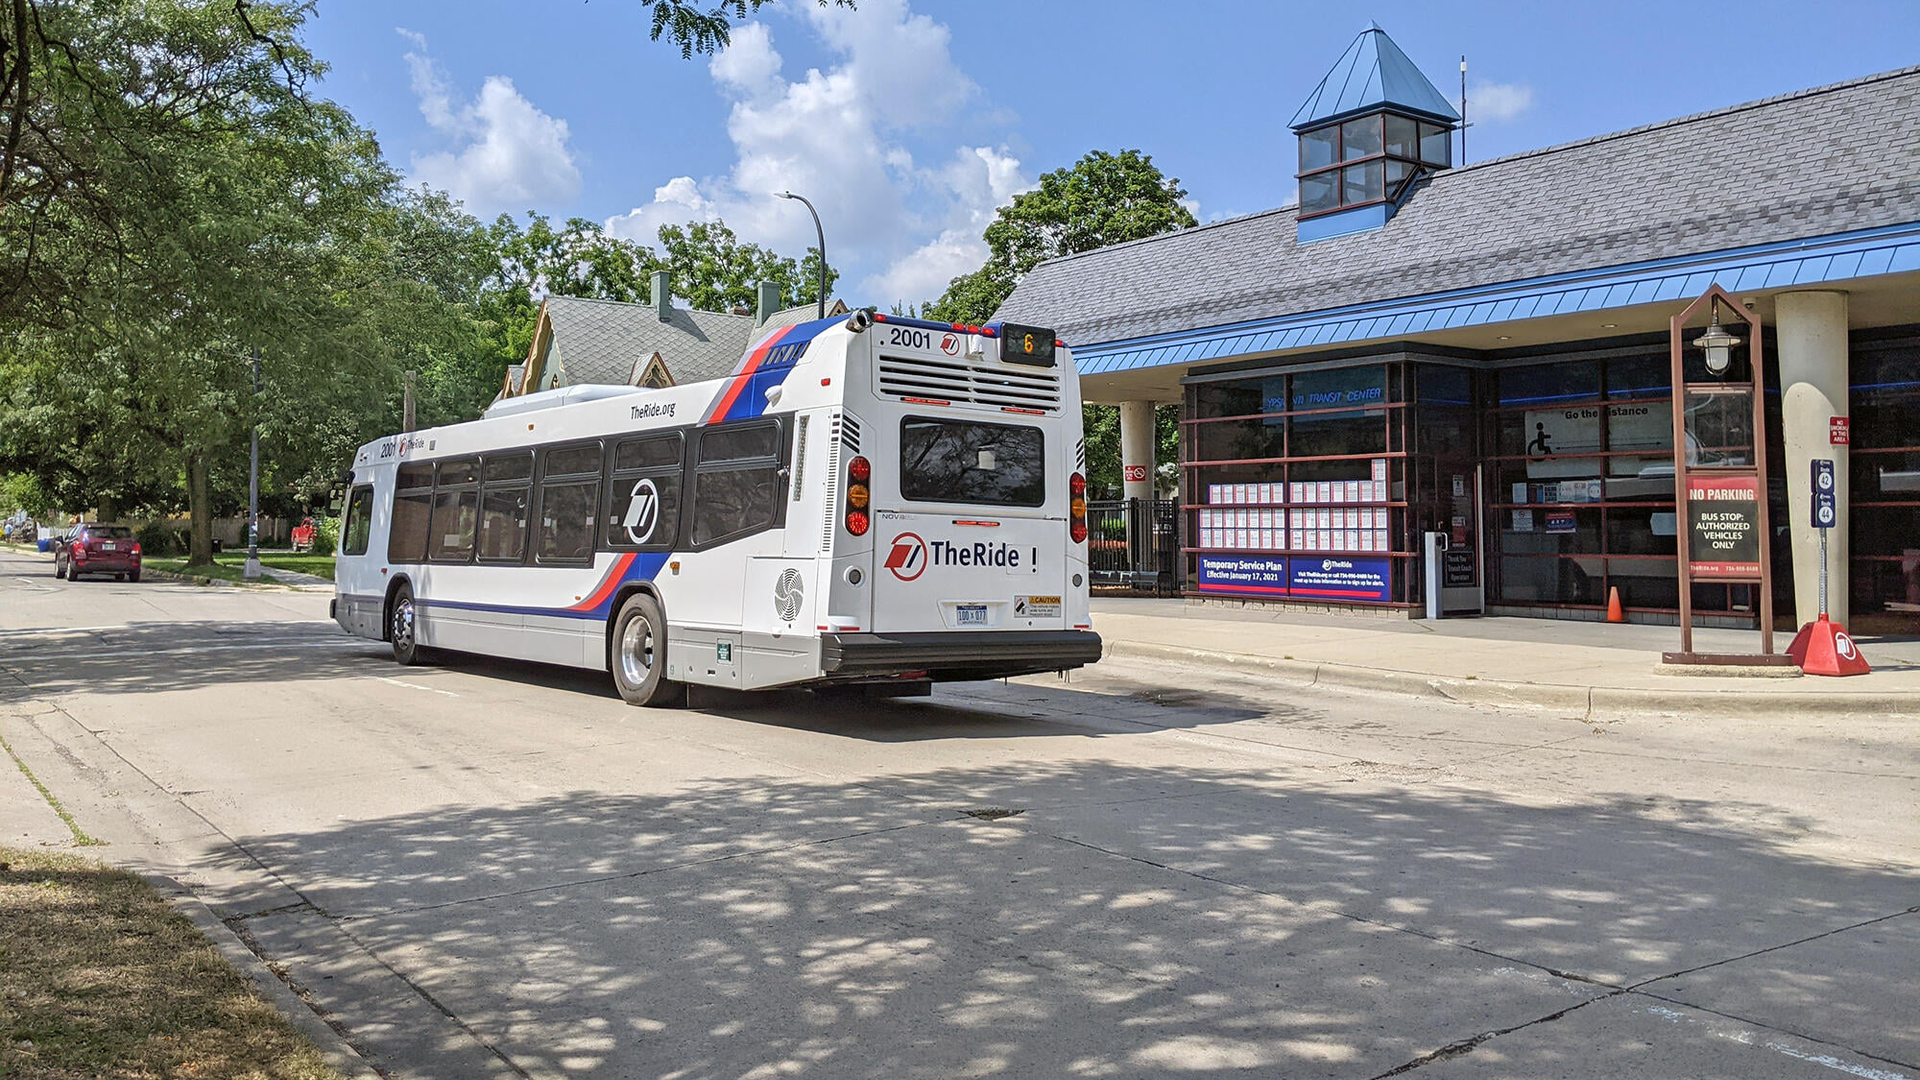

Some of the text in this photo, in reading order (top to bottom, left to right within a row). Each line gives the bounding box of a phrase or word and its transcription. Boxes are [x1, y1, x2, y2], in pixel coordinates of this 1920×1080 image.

[891, 328, 930, 349] 2001
[1024, 333, 1034, 353] 6
[1267, 388, 1381, 407] YPSINTI TRANSIT CENTER
[631, 402, 677, 419] TheRide.org
[1565, 407, 1648, 419] Go the istance
[381, 442, 397, 458] 2001
[1821, 475, 1829, 485] 42
[1690, 489, 1754, 501] NO PARKING
[1701, 513, 1744, 521] BUS STOP:
[1821, 510, 1830, 518] 44
[1712, 541, 1735, 549] ONLY
[930, 540, 1019, 567] TheRide
[1203, 560, 1282, 571] Temporary Service Plan
[1206, 570, 1278, 581] Effective January 17, 2021
